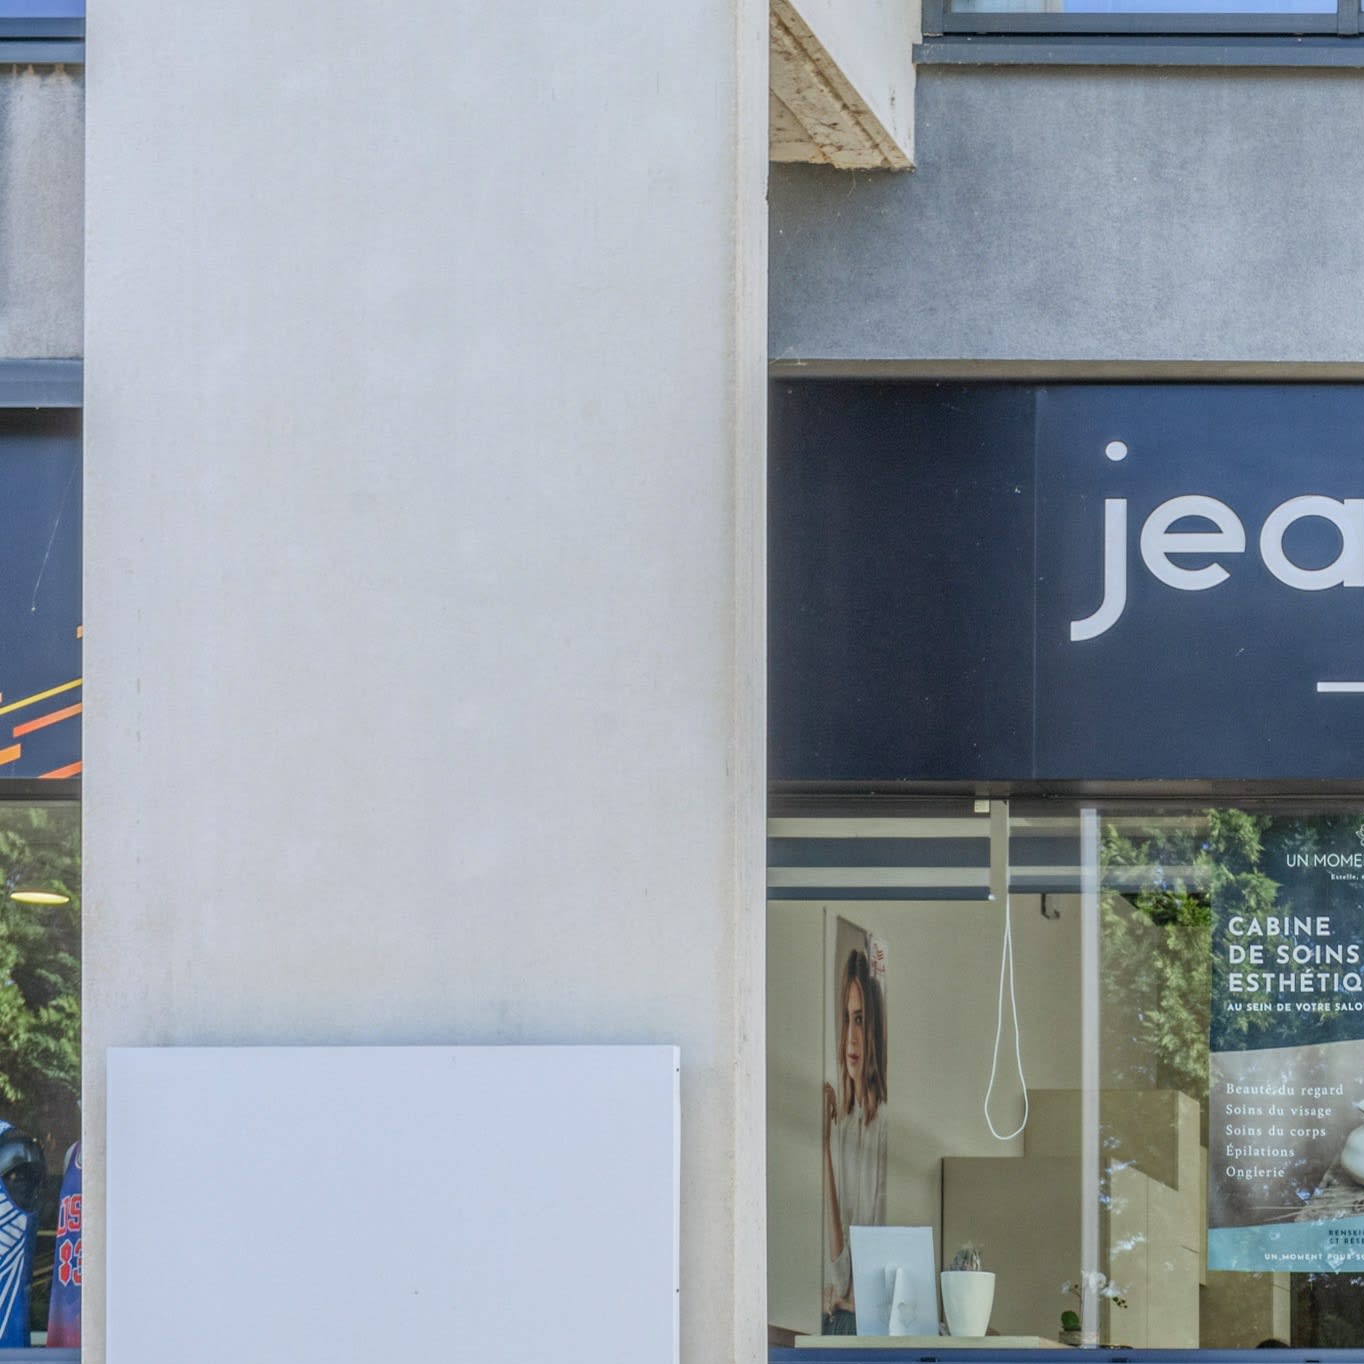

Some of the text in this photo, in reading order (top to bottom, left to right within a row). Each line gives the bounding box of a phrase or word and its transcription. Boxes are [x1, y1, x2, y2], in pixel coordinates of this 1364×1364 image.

[1286, 854, 1309, 867] UN
[1228, 916, 1330, 936] CABINE
[1229, 944, 1360, 964] DE SOINS
[1227, 1002, 1242, 1012] AU
[1246, 1002, 1272, 1012] SEIN
[1276, 1002, 1291, 1012] DE
[1296, 1002, 1331, 1012] VOTRE
[1226, 1082, 1344, 1099] Beauté du regard
[1225, 1104, 1332, 1119] Soins du visage
[1225, 1124, 1326, 1140] Soins du corps
[1226, 1142, 1295, 1159] Épilations
[1226, 1165, 1286, 1180] Onglerie
